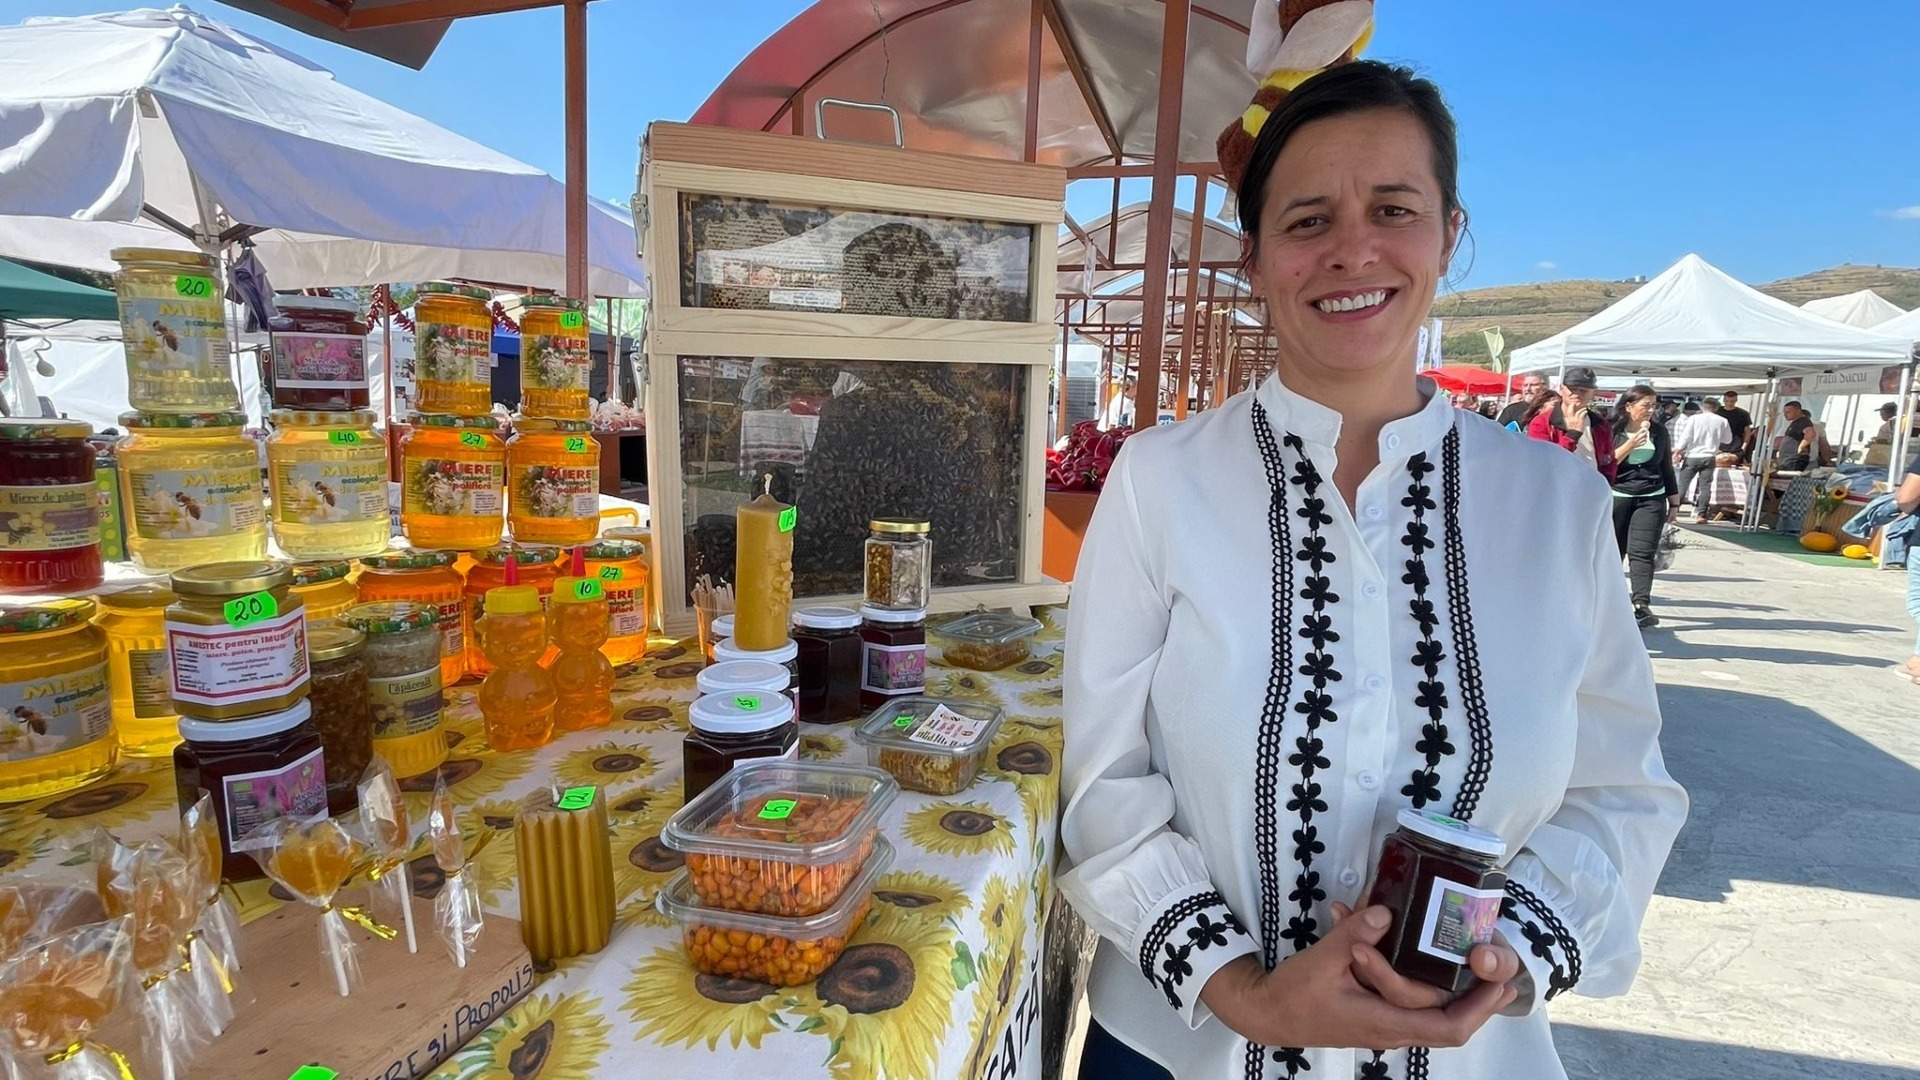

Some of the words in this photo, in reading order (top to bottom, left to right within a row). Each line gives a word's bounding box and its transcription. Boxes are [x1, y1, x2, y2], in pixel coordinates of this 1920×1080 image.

[180, 278, 205, 296] 20
[159, 303, 223, 318] MIER
[566, 312, 577, 326] 14
[337, 432, 355, 443] 40
[463, 432, 480, 445] 27
[568, 438, 584, 451] 27
[439, 461, 492, 474] MIERE
[545, 466, 592, 479] MIERE
[601, 567, 618, 580] 27
[580, 582, 592, 596] 10
[234, 597, 263, 622] 20
[224, 638, 259, 651] pentru
